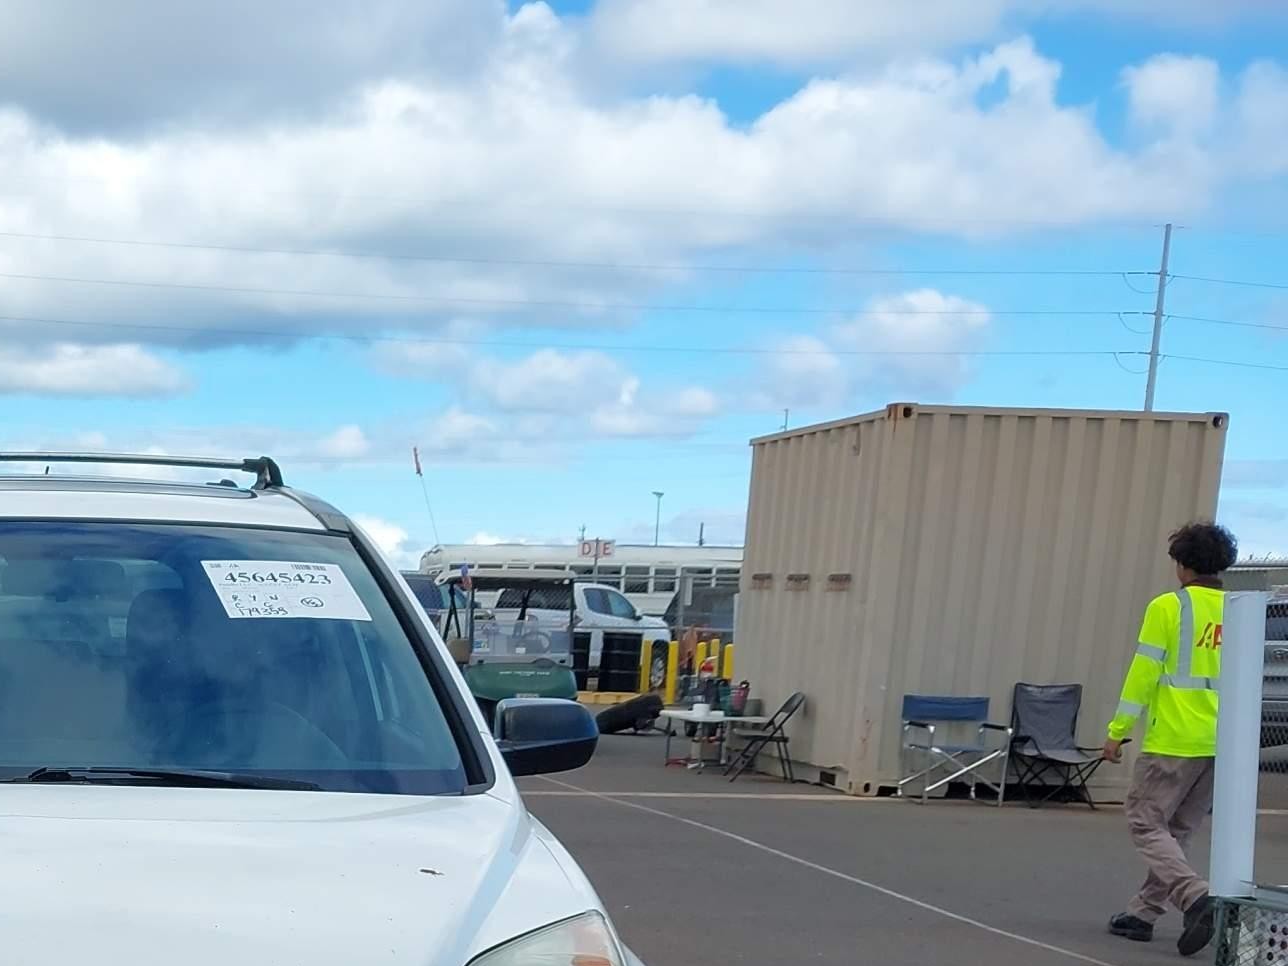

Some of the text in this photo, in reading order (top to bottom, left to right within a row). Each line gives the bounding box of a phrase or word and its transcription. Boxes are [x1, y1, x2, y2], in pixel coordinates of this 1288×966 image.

[582, 542, 592, 556] D
[602, 542, 612, 556] E
[224, 571, 332, 585] 45645423
